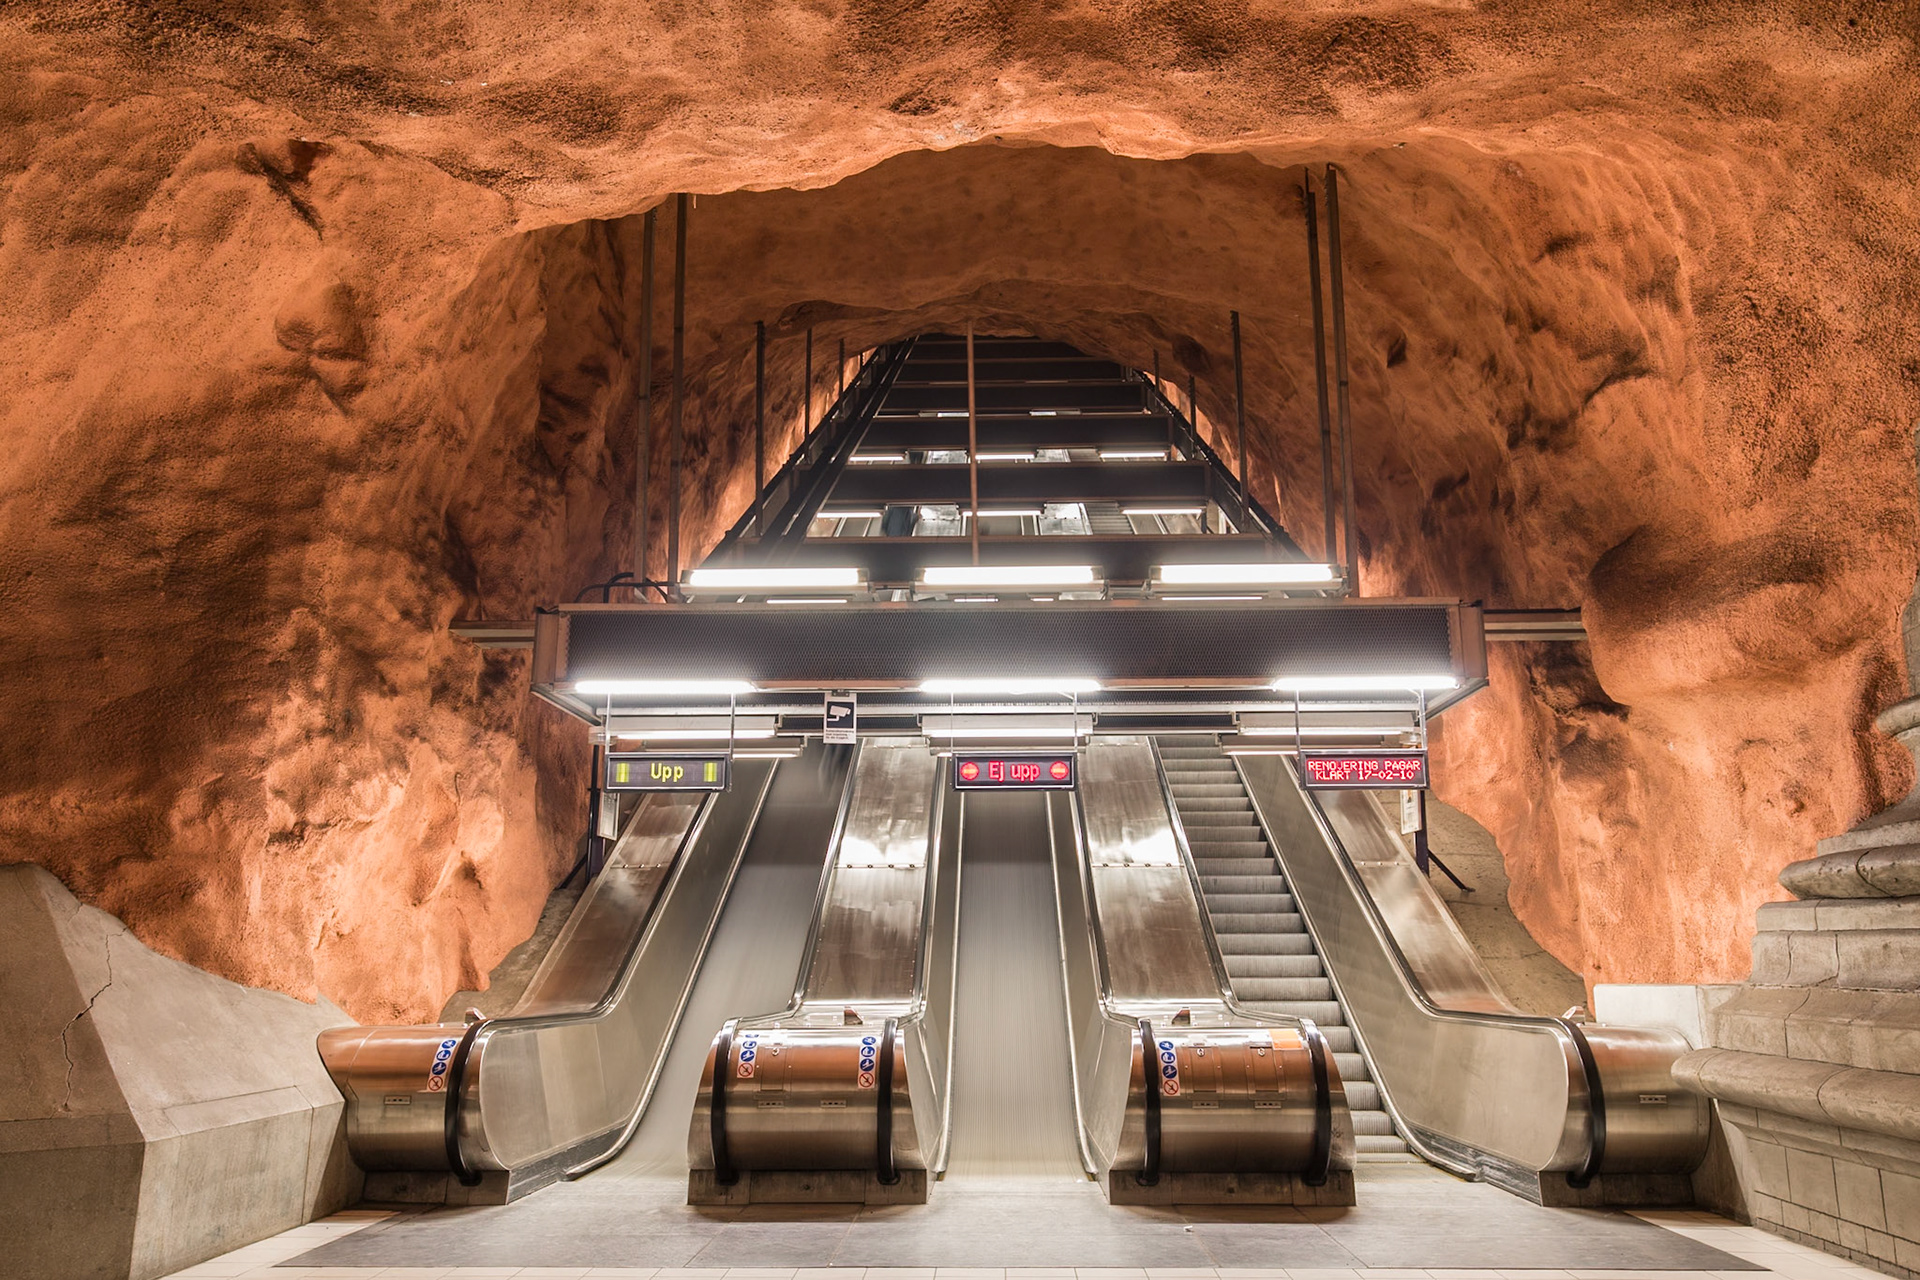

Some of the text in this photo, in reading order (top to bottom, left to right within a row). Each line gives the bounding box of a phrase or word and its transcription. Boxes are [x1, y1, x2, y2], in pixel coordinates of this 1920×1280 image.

[650, 761, 685, 783] Upp
[988, 760, 1041, 783] Ej upp
[1315, 769, 1415, 781] KLART 17-02-10
